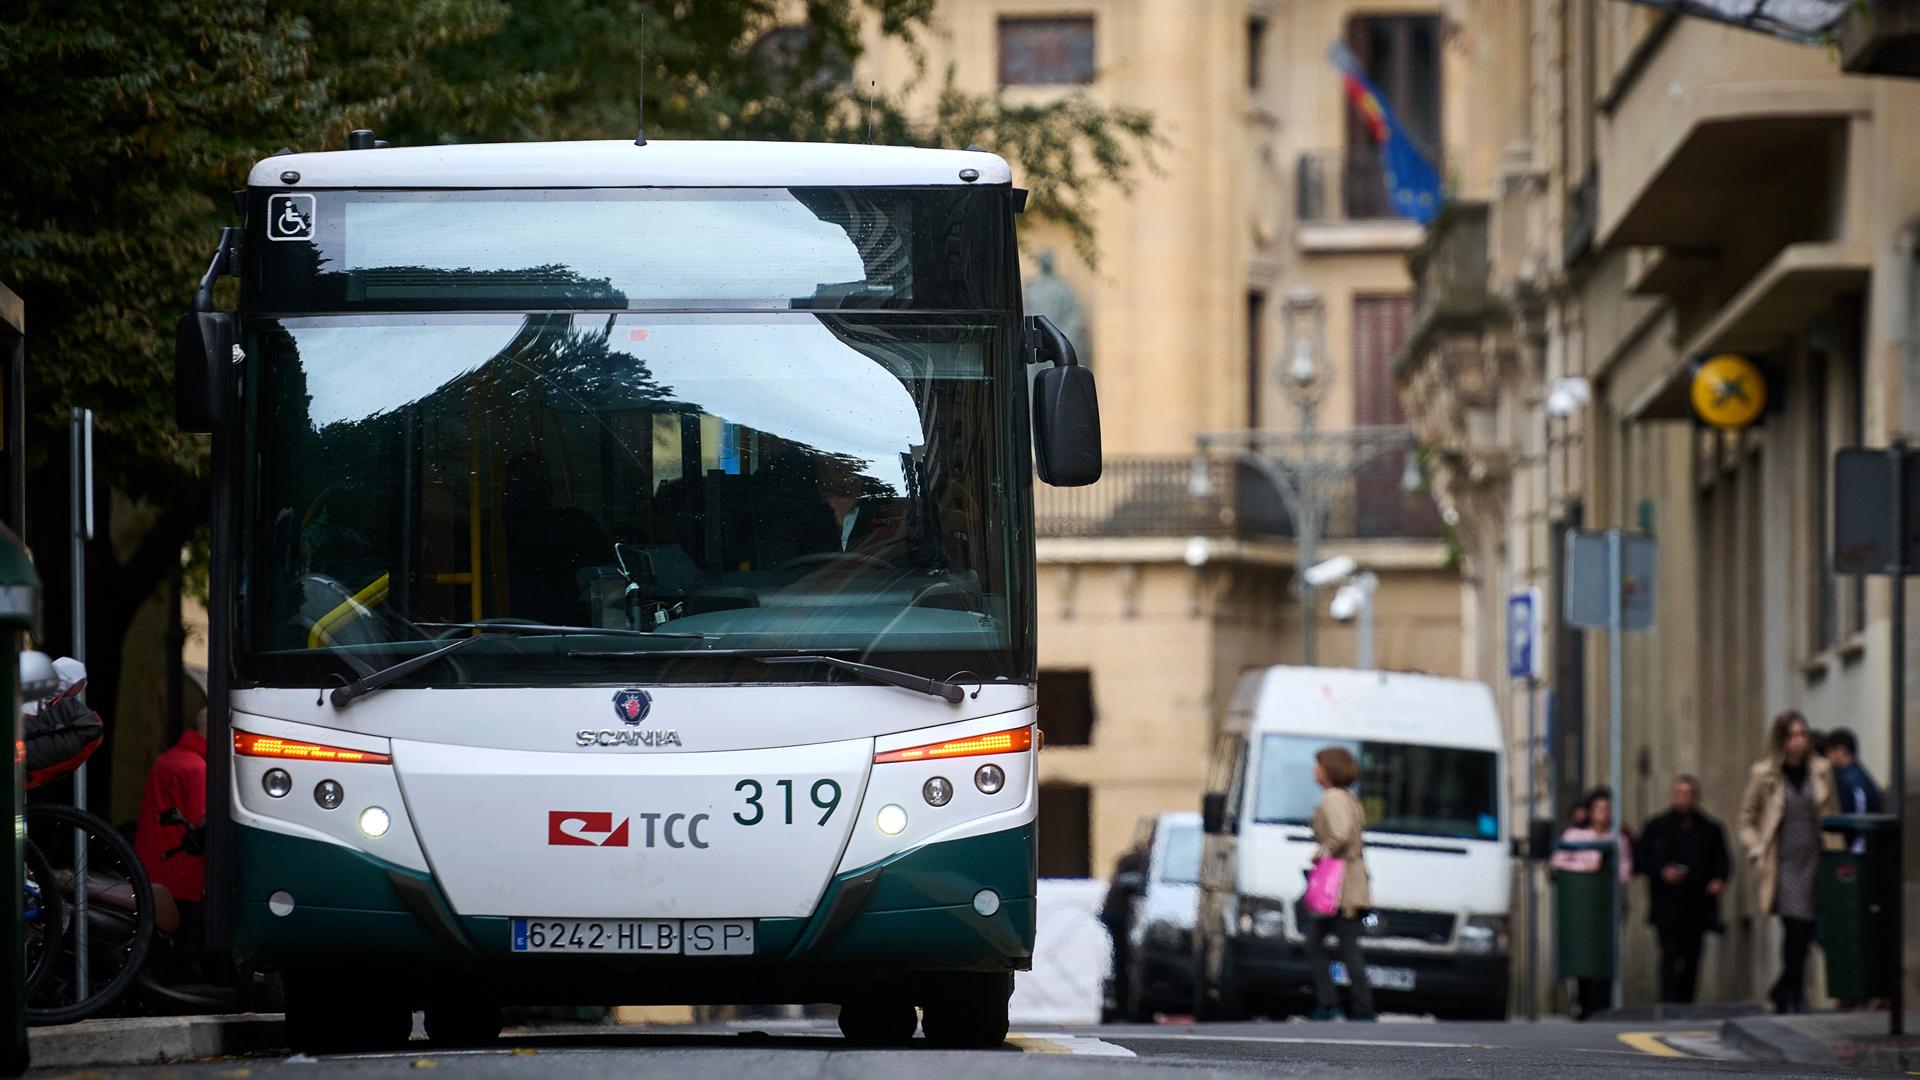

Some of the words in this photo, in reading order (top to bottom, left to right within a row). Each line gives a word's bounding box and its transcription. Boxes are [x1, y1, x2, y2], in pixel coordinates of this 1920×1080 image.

[576, 729, 682, 747] SCANIA
[732, 778, 842, 827] 319
[640, 812, 710, 849] TCC
